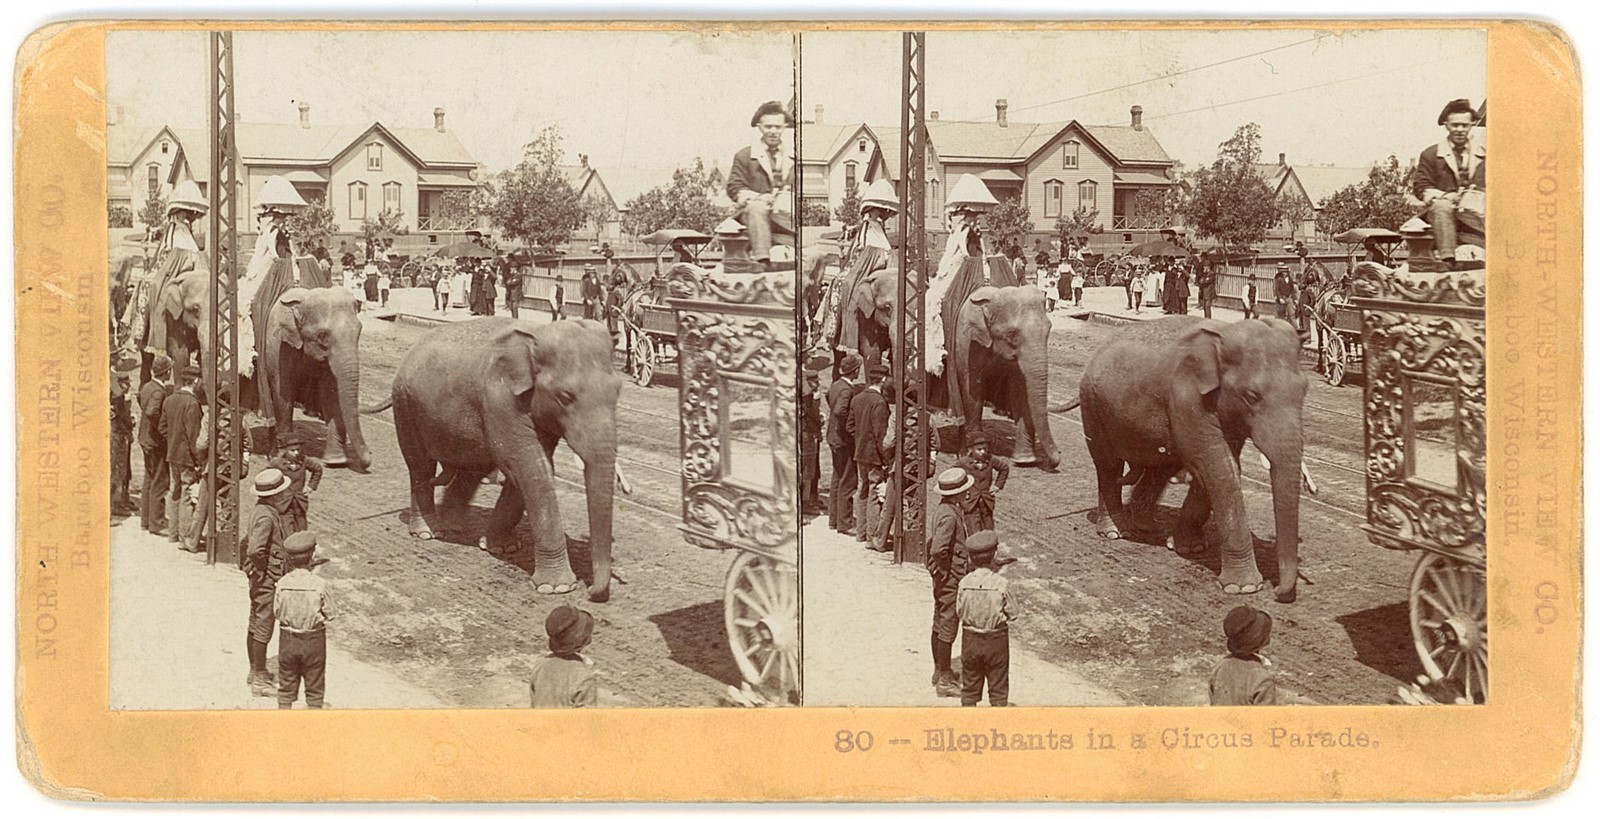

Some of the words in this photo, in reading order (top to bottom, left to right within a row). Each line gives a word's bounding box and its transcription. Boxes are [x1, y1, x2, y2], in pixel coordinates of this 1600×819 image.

[1504, 240, 1527, 364] Baraboo
[1535, 148, 1558, 455] NORTH-WESTERN
[71, 446, 92, 570] Baraboo
[1503, 378, 1527, 546] Wisconsin.
[1534, 468, 1559, 567] VIEW
[1534, 581, 1560, 635] CO.
[834, 729, 874, 753] 80
[923, 728, 1075, 755] Elephants
[1088, 728, 1116, 751] in
[1131, 734, 1147, 750] a
[1161, 728, 1255, 750] Circus
[1269, 728, 1384, 750] Parade.
